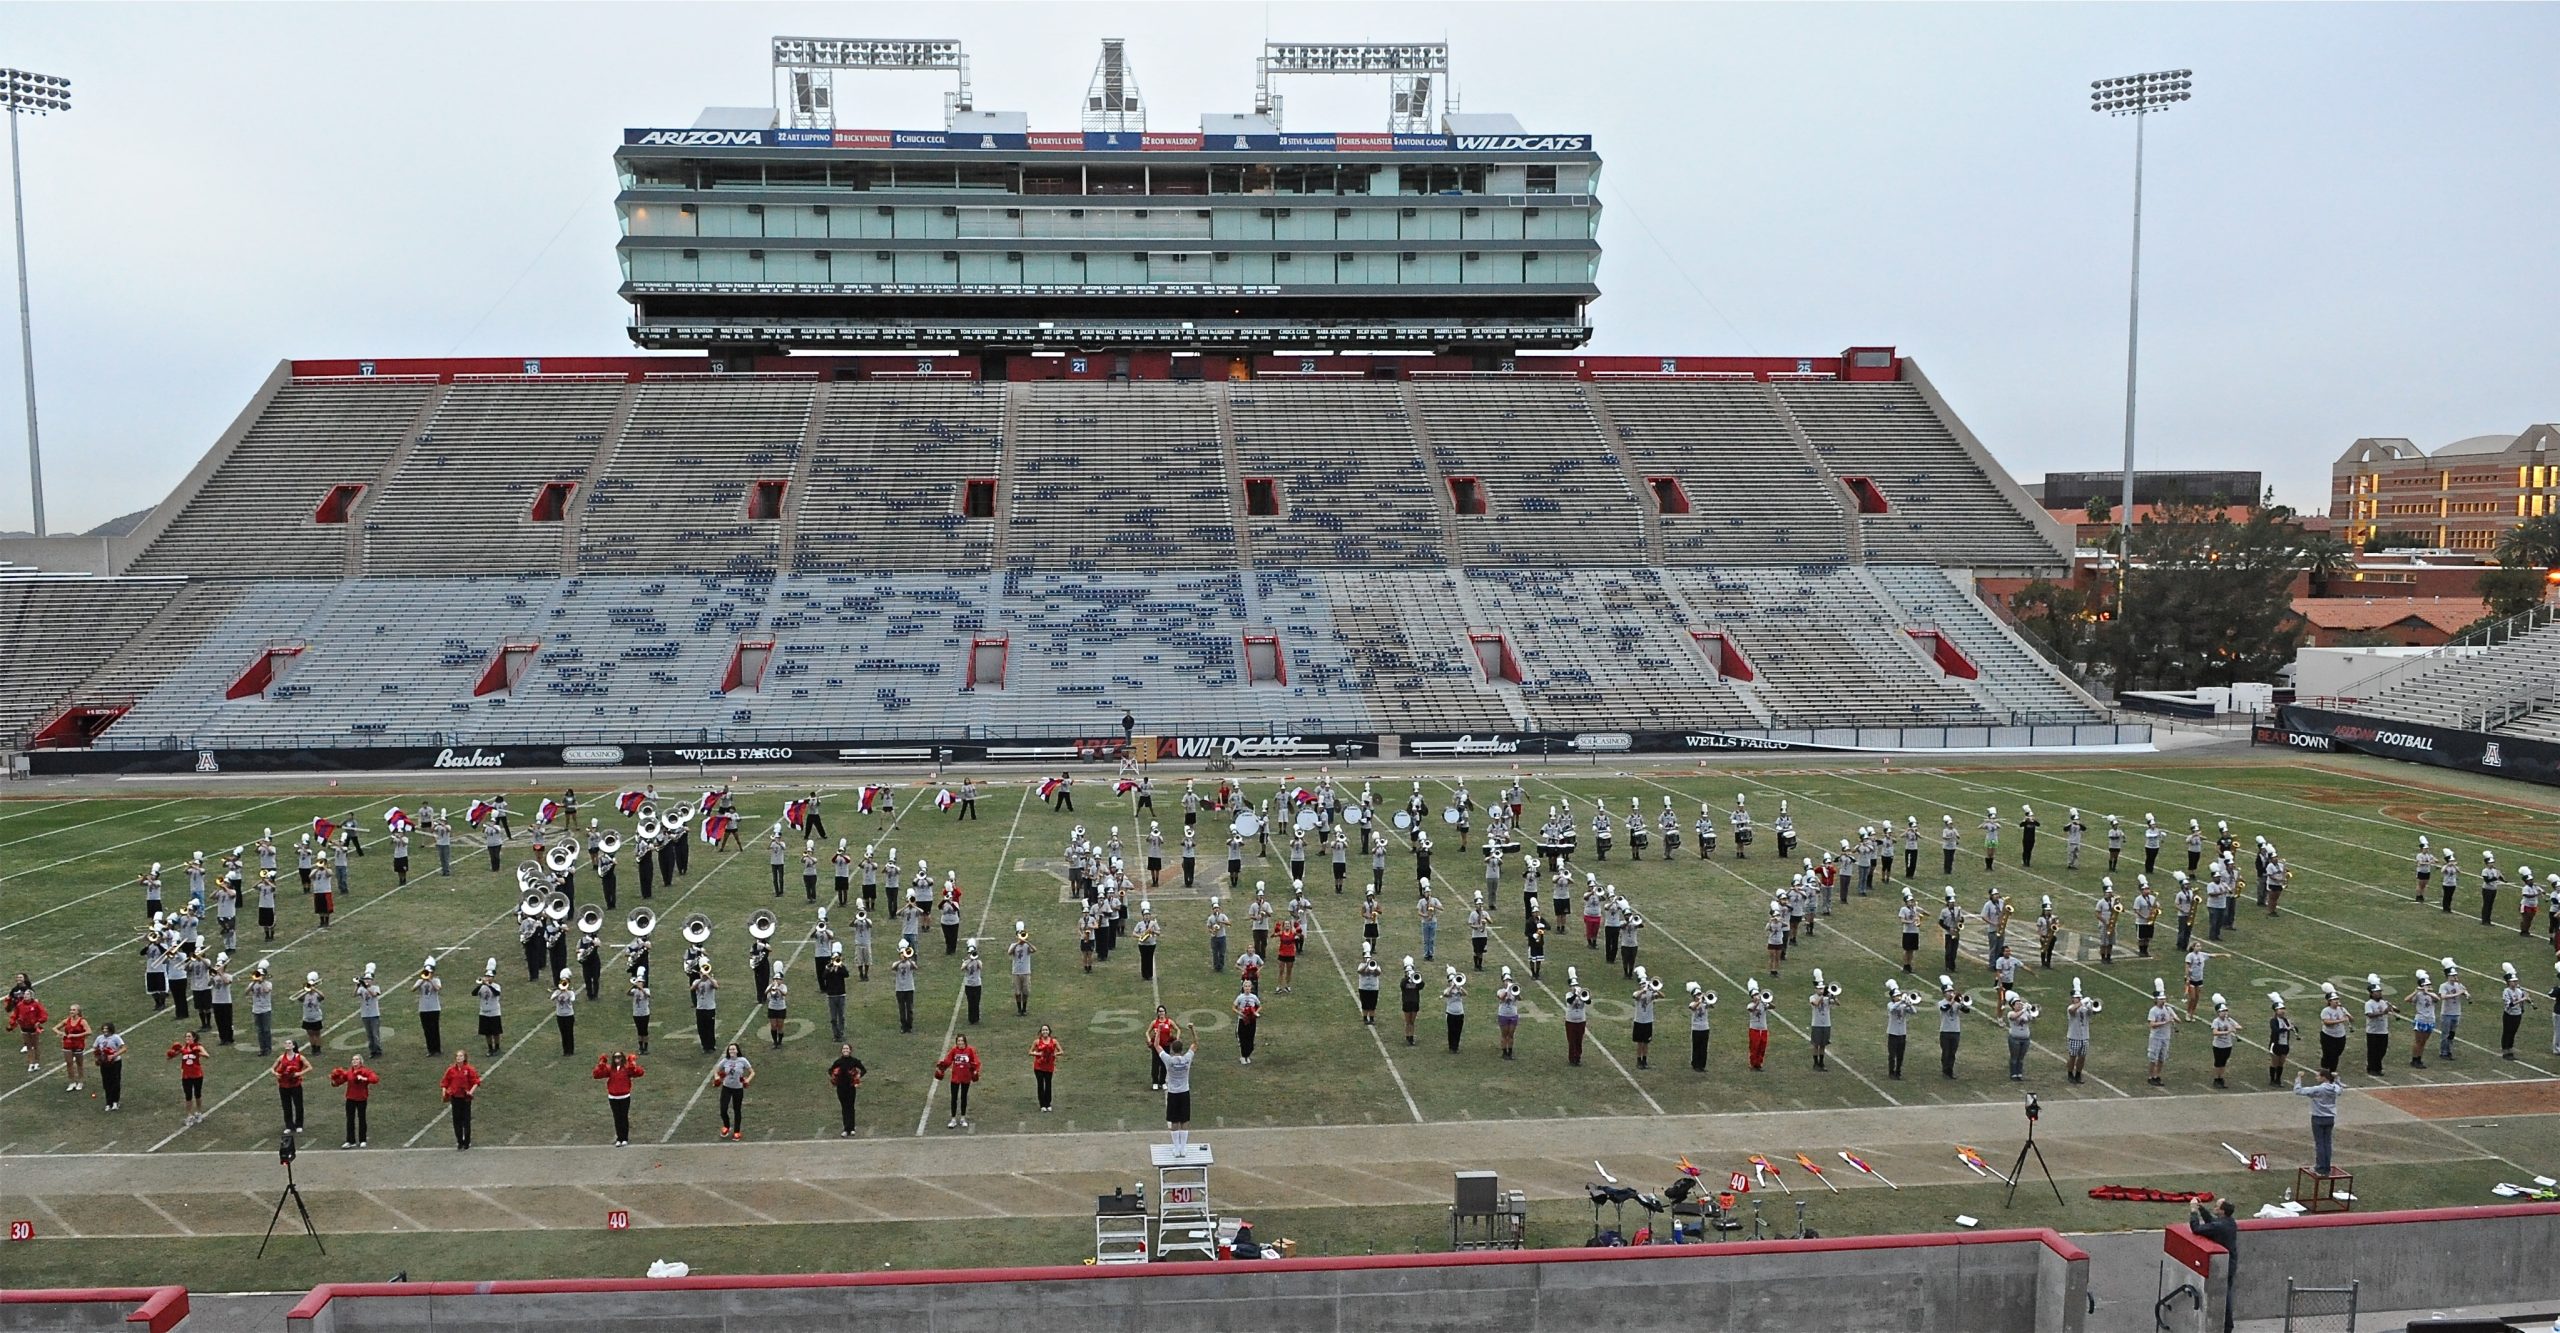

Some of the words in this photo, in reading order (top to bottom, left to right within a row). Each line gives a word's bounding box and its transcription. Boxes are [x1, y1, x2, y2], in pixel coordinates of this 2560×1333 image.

[638, 131, 762, 145] ARIZONA
[778, 133, 786, 142] 22
[787, 133, 800, 142] ART
[802, 133, 830, 142] LUPPINO
[843, 134, 862, 143] RICKY
[864, 134, 891, 143] HUNLEY
[902, 134, 926, 144] CHUCK
[926, 134, 946, 144] CECIL
[1028, 136, 1033, 145] 4
[1034, 136, 1061, 145] DARRYLL
[1062, 136, 1083, 145] LEWIS
[1142, 137, 1150, 145] 92
[1150, 137, 1164, 145] ROB
[1165, 137, 1198, 145] WALDROP
[1288, 137, 1302, 145] STEVE
[1302, 137, 1335, 145] McLAUGHLIN
[1336, 137, 1342, 146] 11
[1343, 137, 1360, 146] CHRIS
[1361, 137, 1392, 146] McALISTER
[1399, 137, 1426, 146] ANTOINE
[1426, 137, 1448, 146] CASON
[1456, 136, 1584, 150] WILDCATS
[361, 366, 374, 376] 17
[526, 364, 538, 374] 18
[711, 363, 723, 373] 19
[918, 363, 932, 372] 20
[1073, 362, 1085, 372] 21
[1301, 362, 1315, 372] 22
[1501, 362, 1514, 372] 23
[1662, 364, 1675, 373] 24
[1798, 364, 1810, 373] 25
[1685, 736, 1737, 747] WELLS
[2256, 729, 2289, 744] BEAR
[2289, 733, 2329, 749] DOWN
[2375, 730, 2433, 750] FOOTBALL
[434, 748, 505, 768] Bashas'
[683, 749, 736, 760] WELLS
[739, 748, 792, 759] FARGO
[1089, 1009, 1232, 1034] 50
[2253, 1155, 2267, 1170] 30
[1731, 1174, 1746, 1191] 40
[1174, 1188, 1190, 1203] 50
[610, 1212, 627, 1229] 40
[12, 1222, 30, 1240] 30
